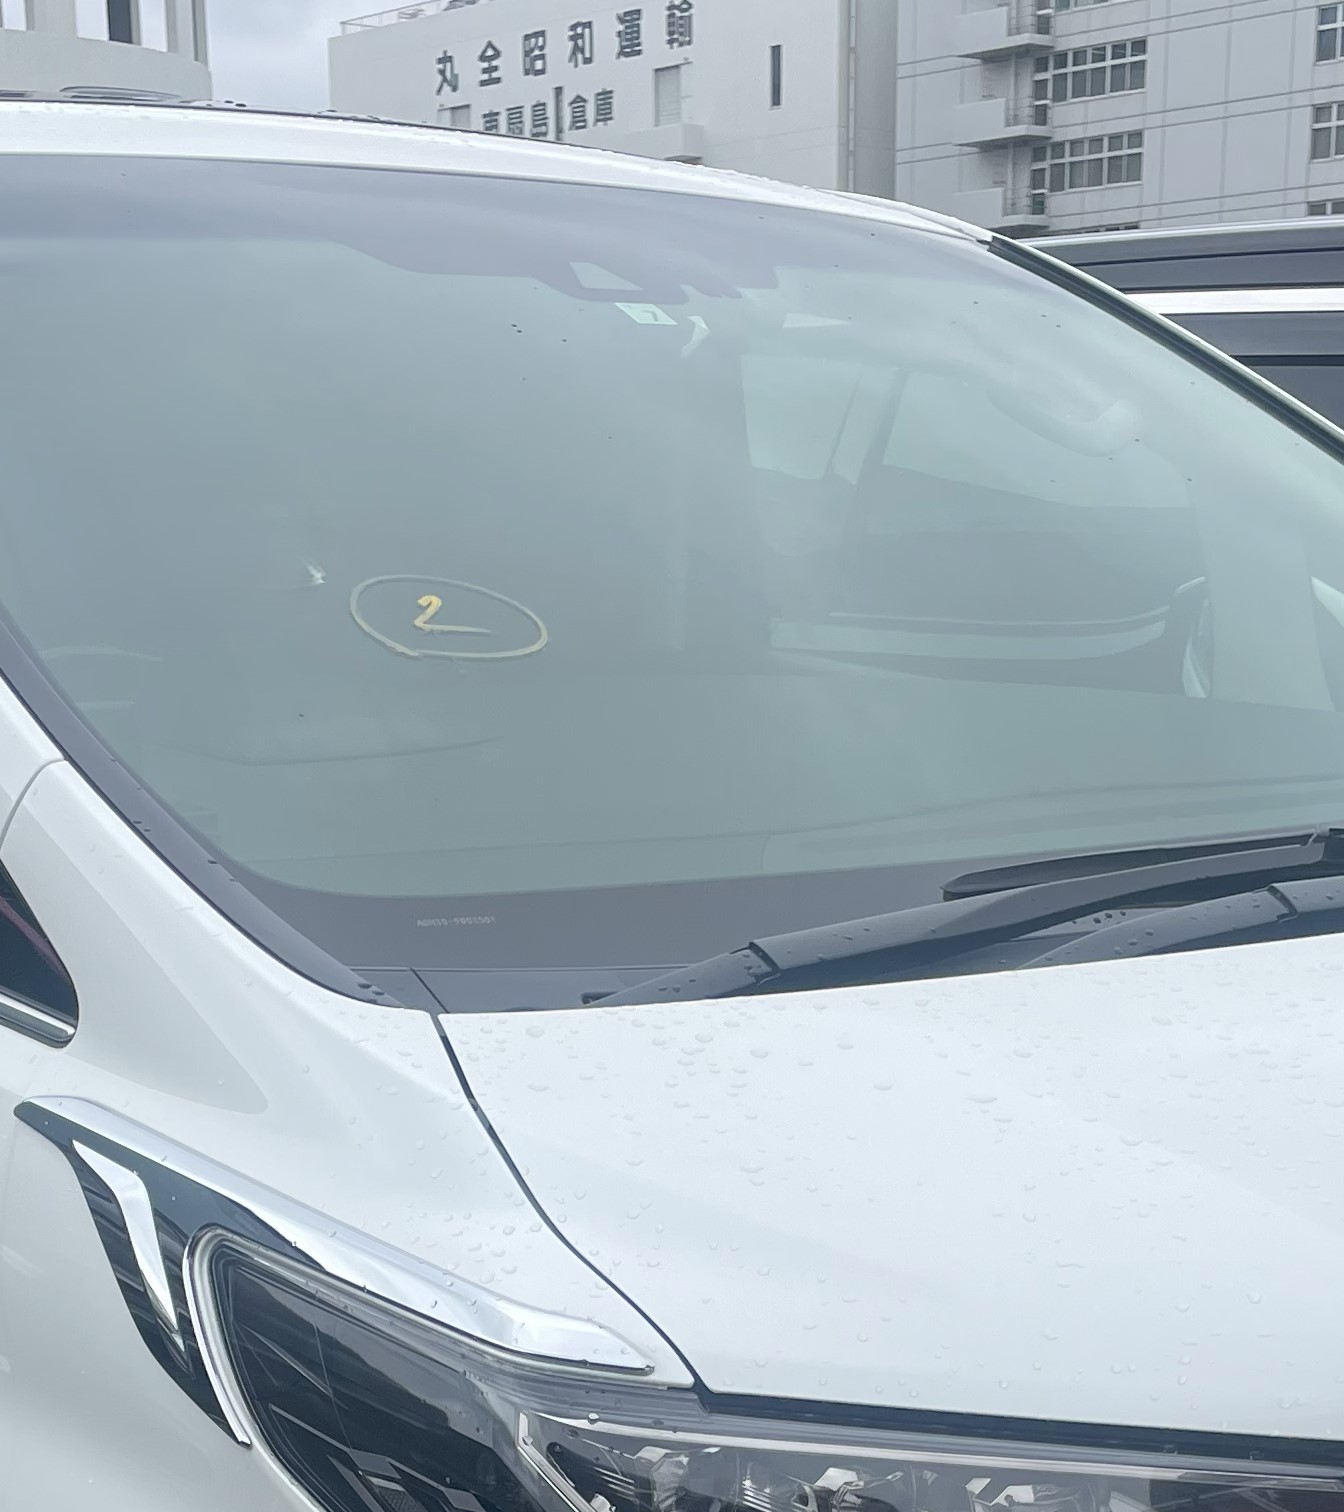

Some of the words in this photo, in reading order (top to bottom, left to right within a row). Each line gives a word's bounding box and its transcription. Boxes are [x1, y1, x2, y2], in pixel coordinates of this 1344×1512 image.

[436, 0, 693, 96] 丸全昭和運輸
[414, 595, 491, 632] 2
